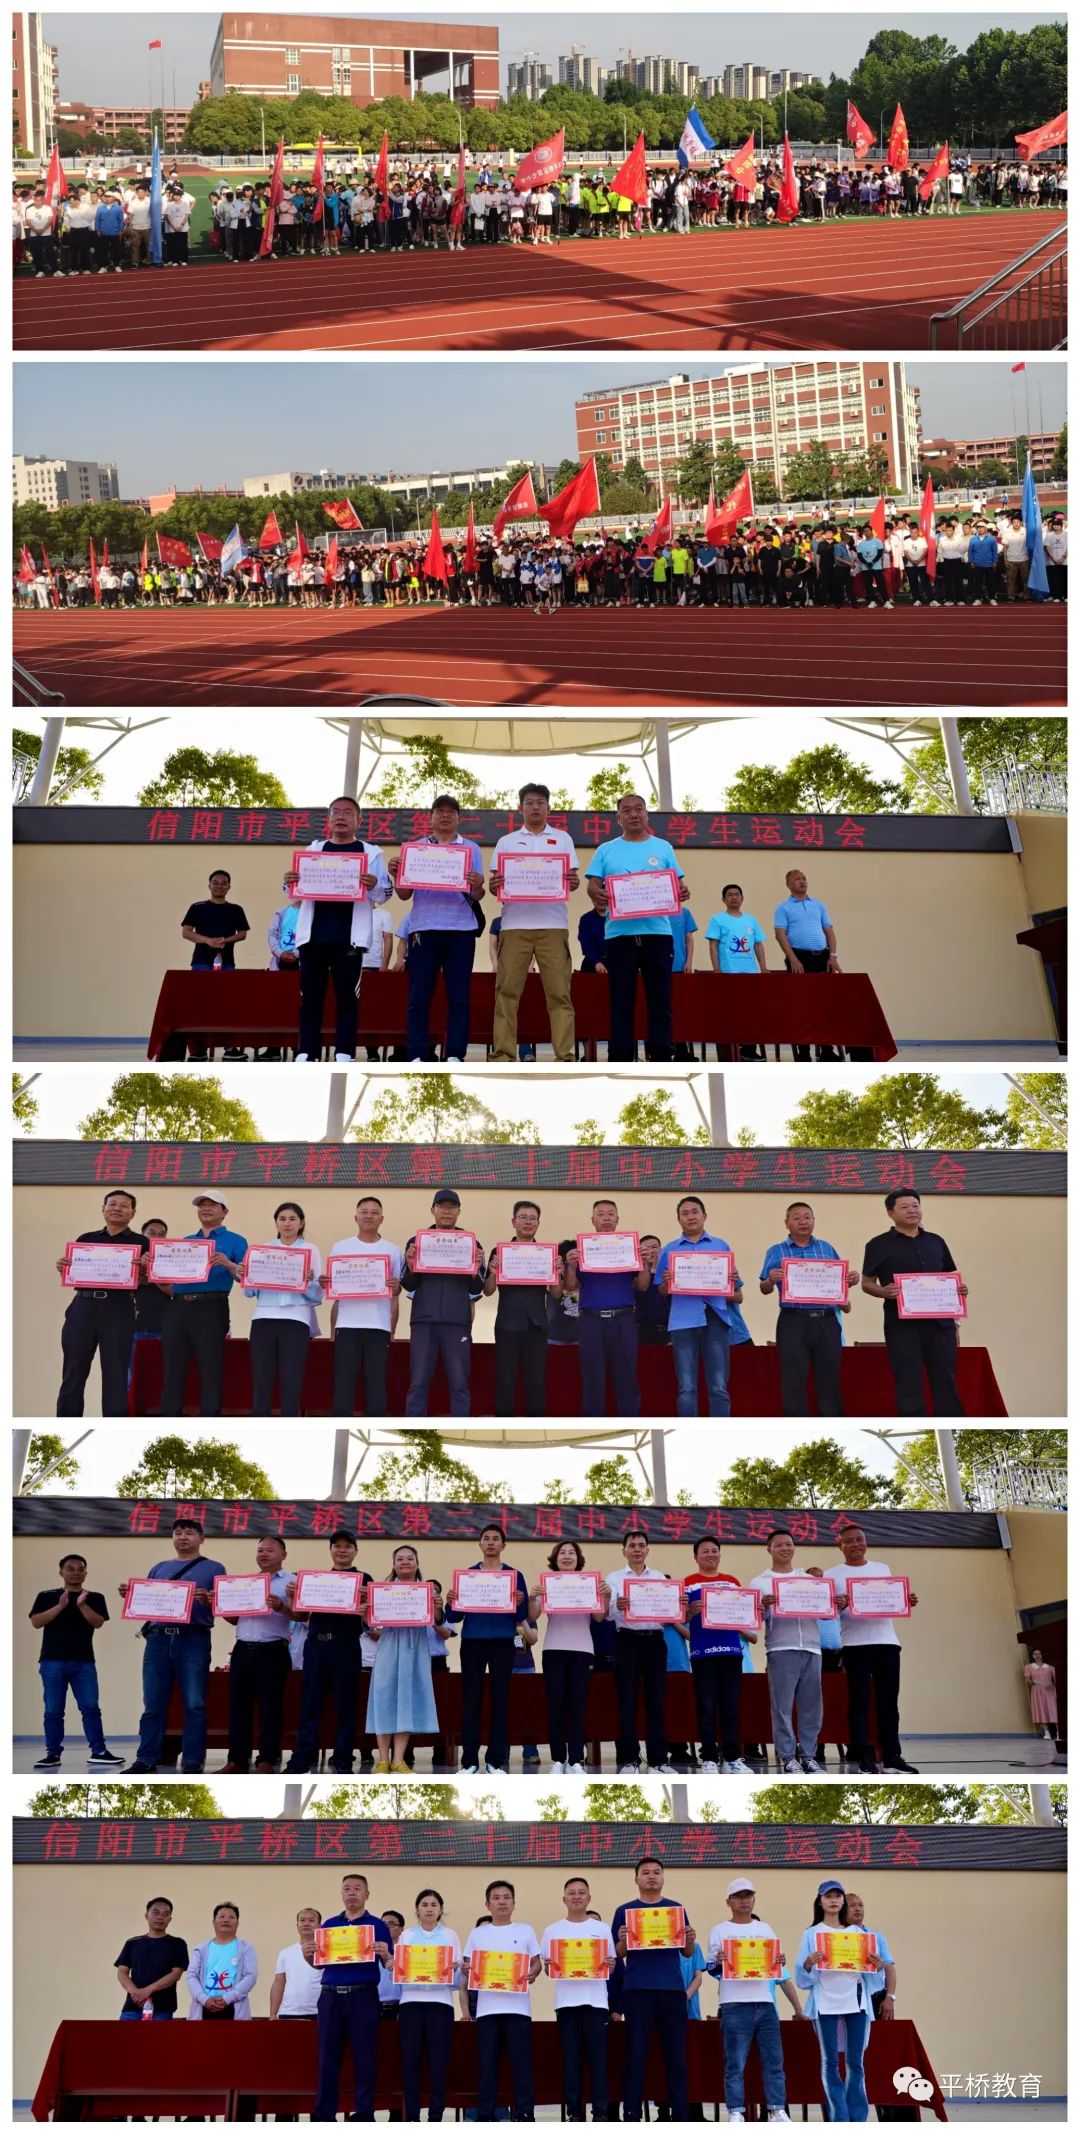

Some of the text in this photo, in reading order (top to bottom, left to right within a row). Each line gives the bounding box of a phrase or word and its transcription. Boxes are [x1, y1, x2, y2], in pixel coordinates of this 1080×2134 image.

[93, 1144, 967, 1190] 信阳市平桥区第二十届中小学生运动会
[704, 1646, 731, 1654] adidas
[42, 1822, 923, 1866] 信阳市平桥区第二十届中小学生运动会
